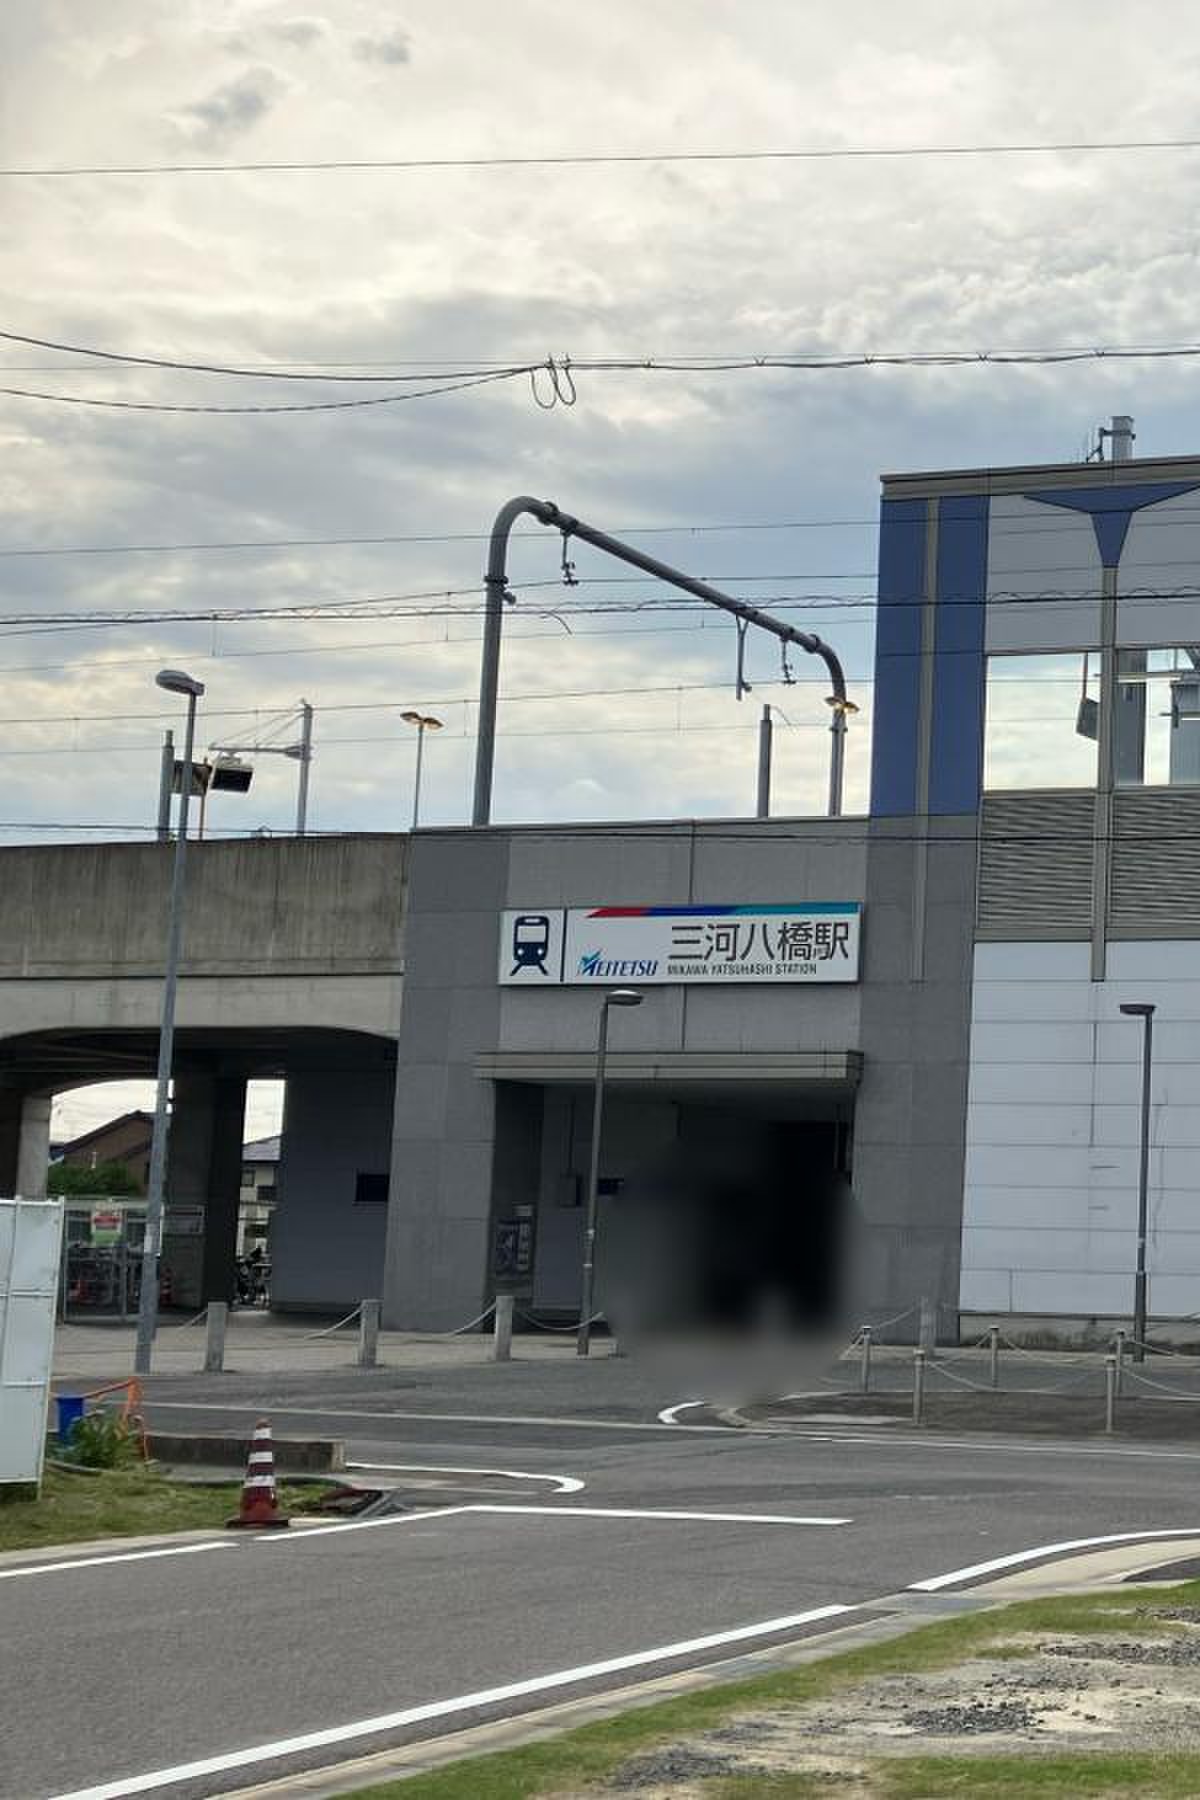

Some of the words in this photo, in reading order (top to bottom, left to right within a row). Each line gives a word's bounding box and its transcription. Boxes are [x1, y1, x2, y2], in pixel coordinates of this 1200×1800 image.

[668, 922, 849, 961] 三河八橋駅
[581, 951, 658, 976] MEITETSU
[667, 963, 708, 976] MIKAWA
[776, 962, 817, 975] STATION
